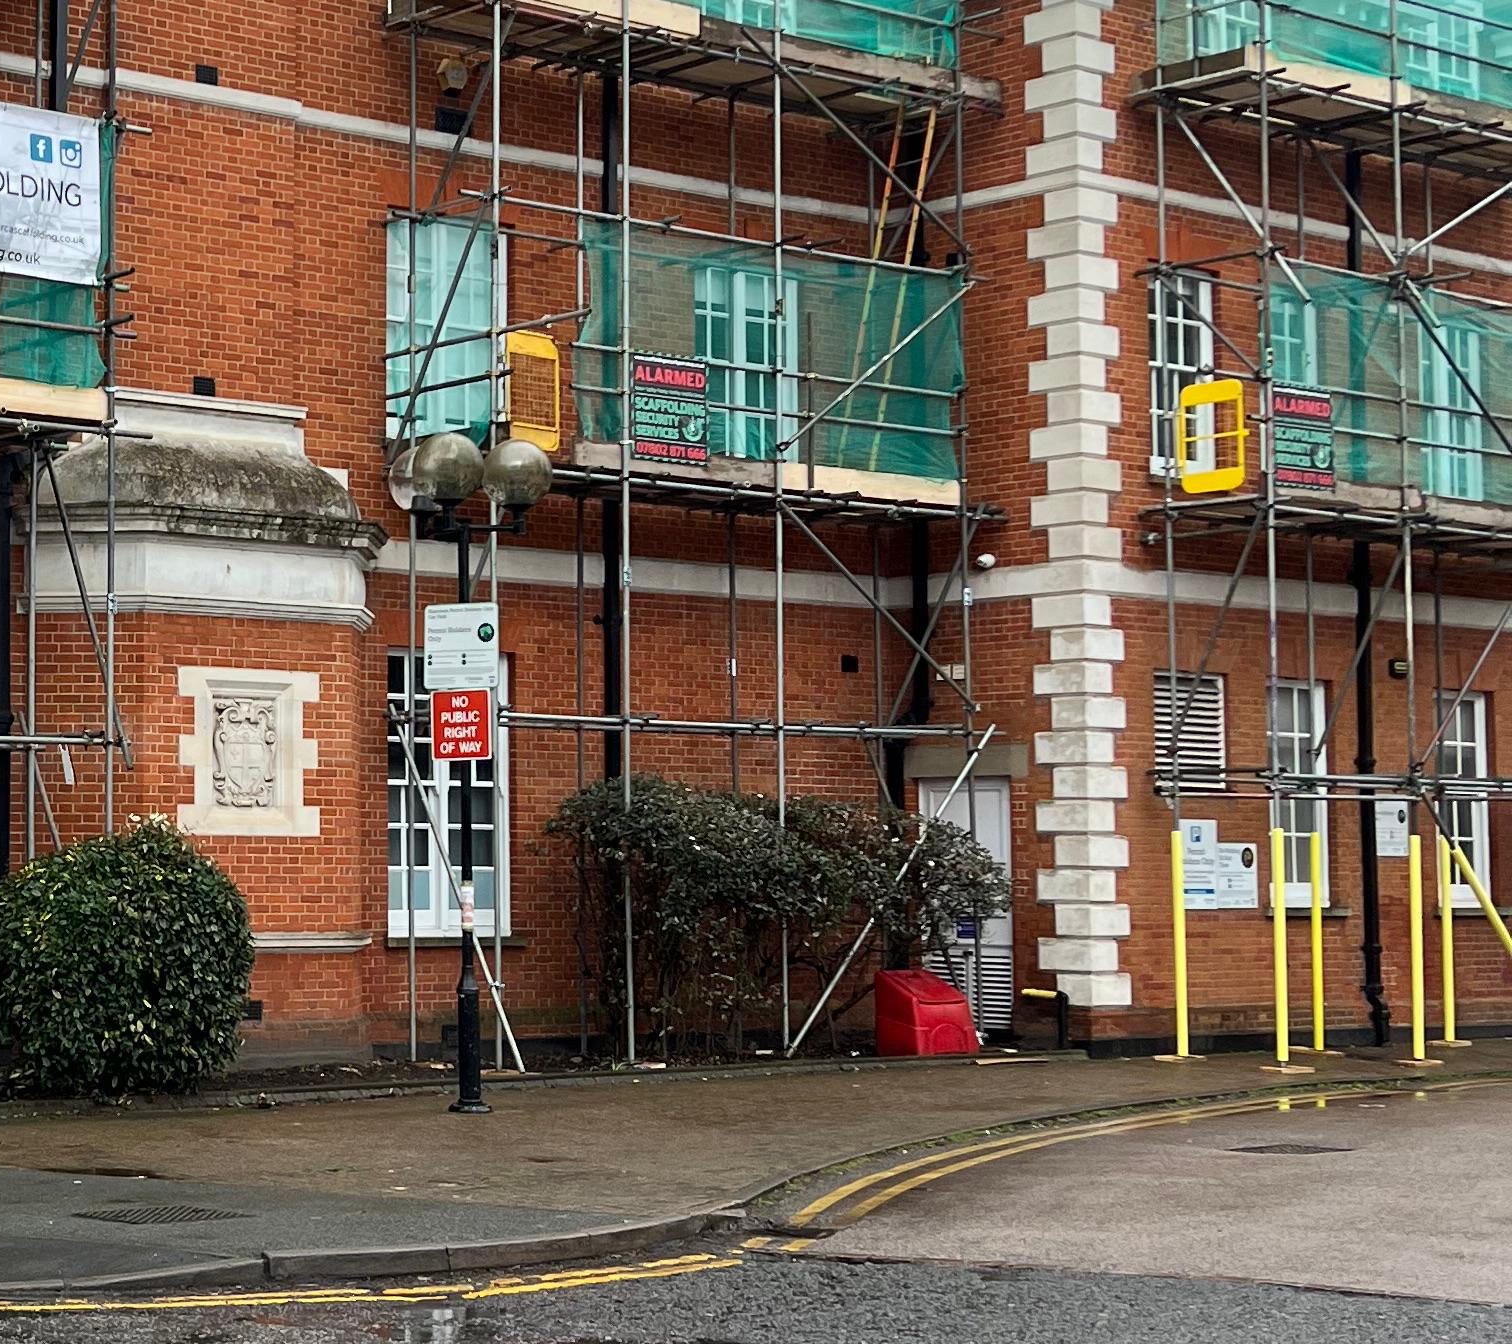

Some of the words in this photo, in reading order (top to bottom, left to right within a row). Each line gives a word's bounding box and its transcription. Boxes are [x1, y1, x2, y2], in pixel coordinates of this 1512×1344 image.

[635, 365, 705, 388] ALARMED
[634, 396, 706, 417] SCAFFOLDING
[1274, 396, 1332, 417] ALARMED
[635, 411, 680, 427] SECURITY
[635, 424, 679, 440] SERVICES
[451, 695, 469, 708] NO
[440, 710, 480, 724] PUBLIC
[444, 726, 478, 738] RIGHT
[439, 741, 456, 754] OF
[458, 741, 483, 753] WAY
